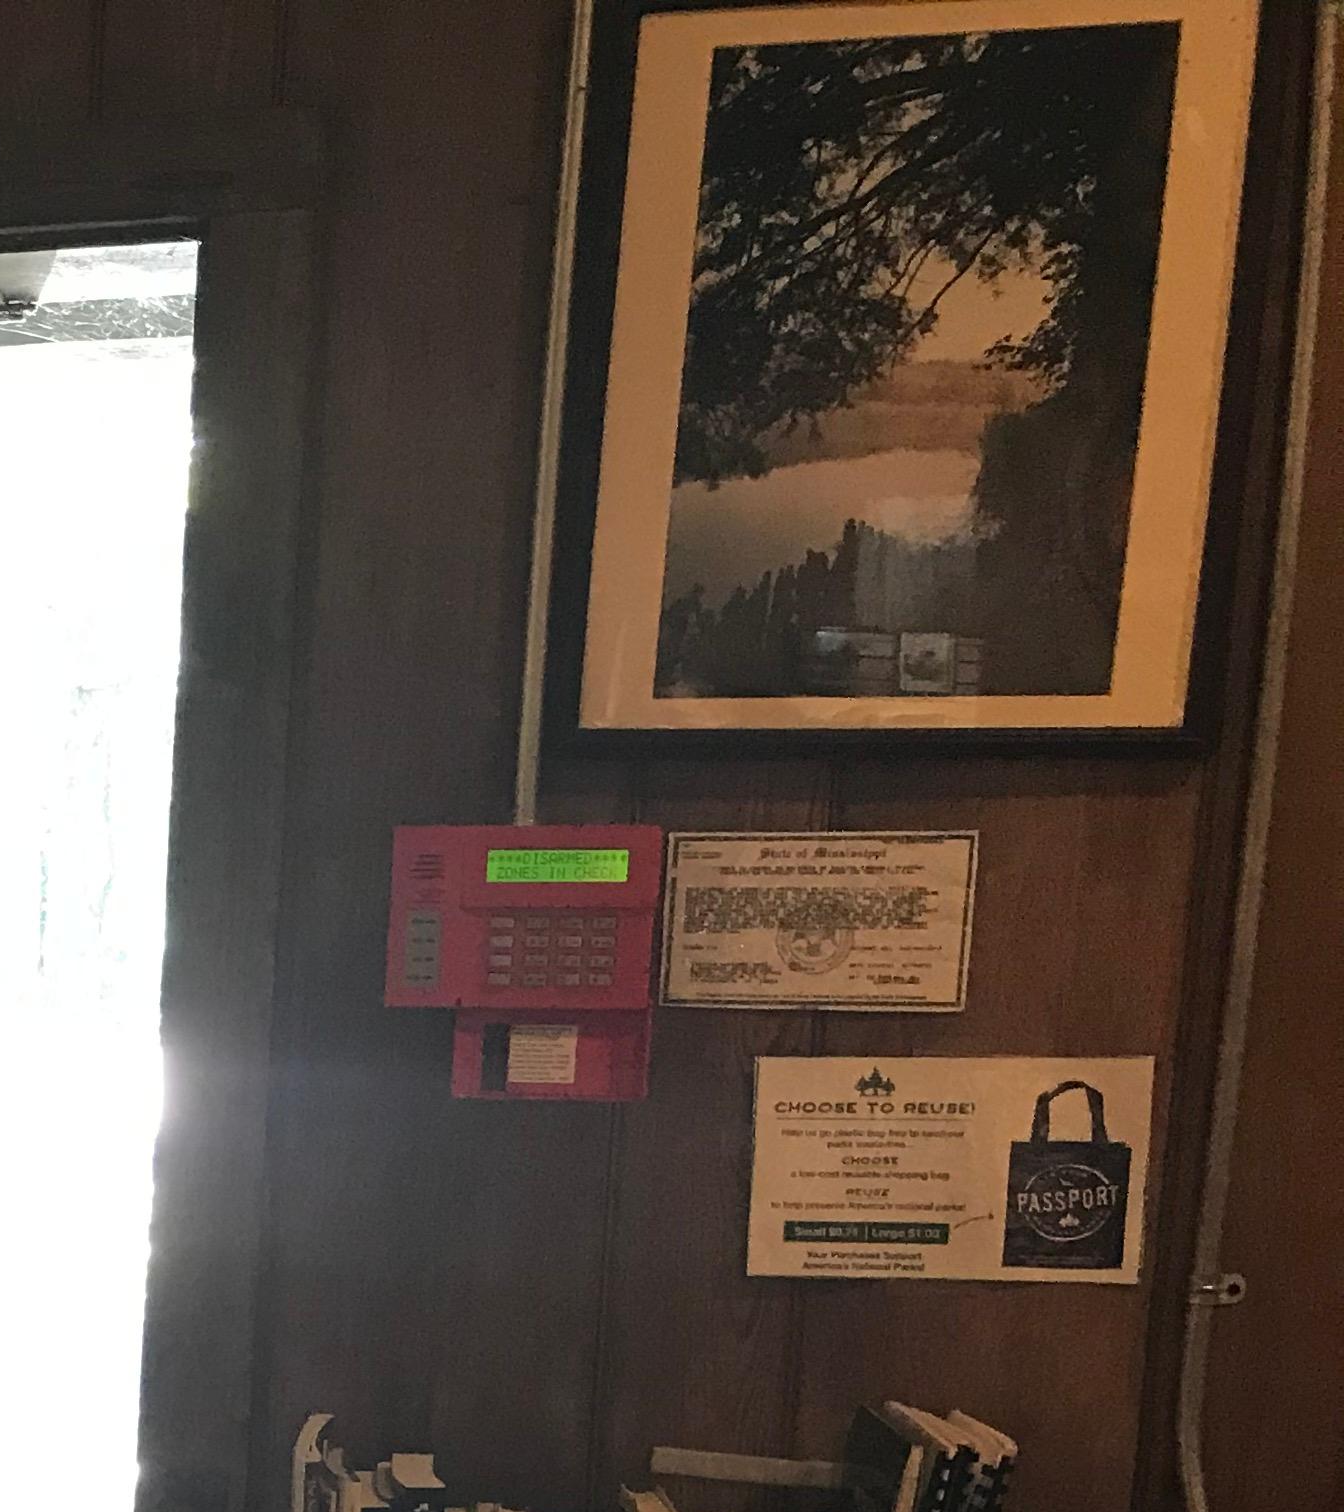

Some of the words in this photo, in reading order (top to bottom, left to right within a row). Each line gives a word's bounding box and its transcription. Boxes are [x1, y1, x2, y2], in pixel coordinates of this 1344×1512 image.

[496, 867, 538, 879] ZONES
[549, 867, 563, 879] IN
[573, 867, 618, 880] CHECK
[774, 1101, 858, 1115] CHOOSE
[867, 1101, 895, 1115] TO
[903, 1101, 976, 1116] REUSE!
[842, 1156, 899, 1165] CHOOSE
[1017, 1185, 1120, 1213] PASSPORT
